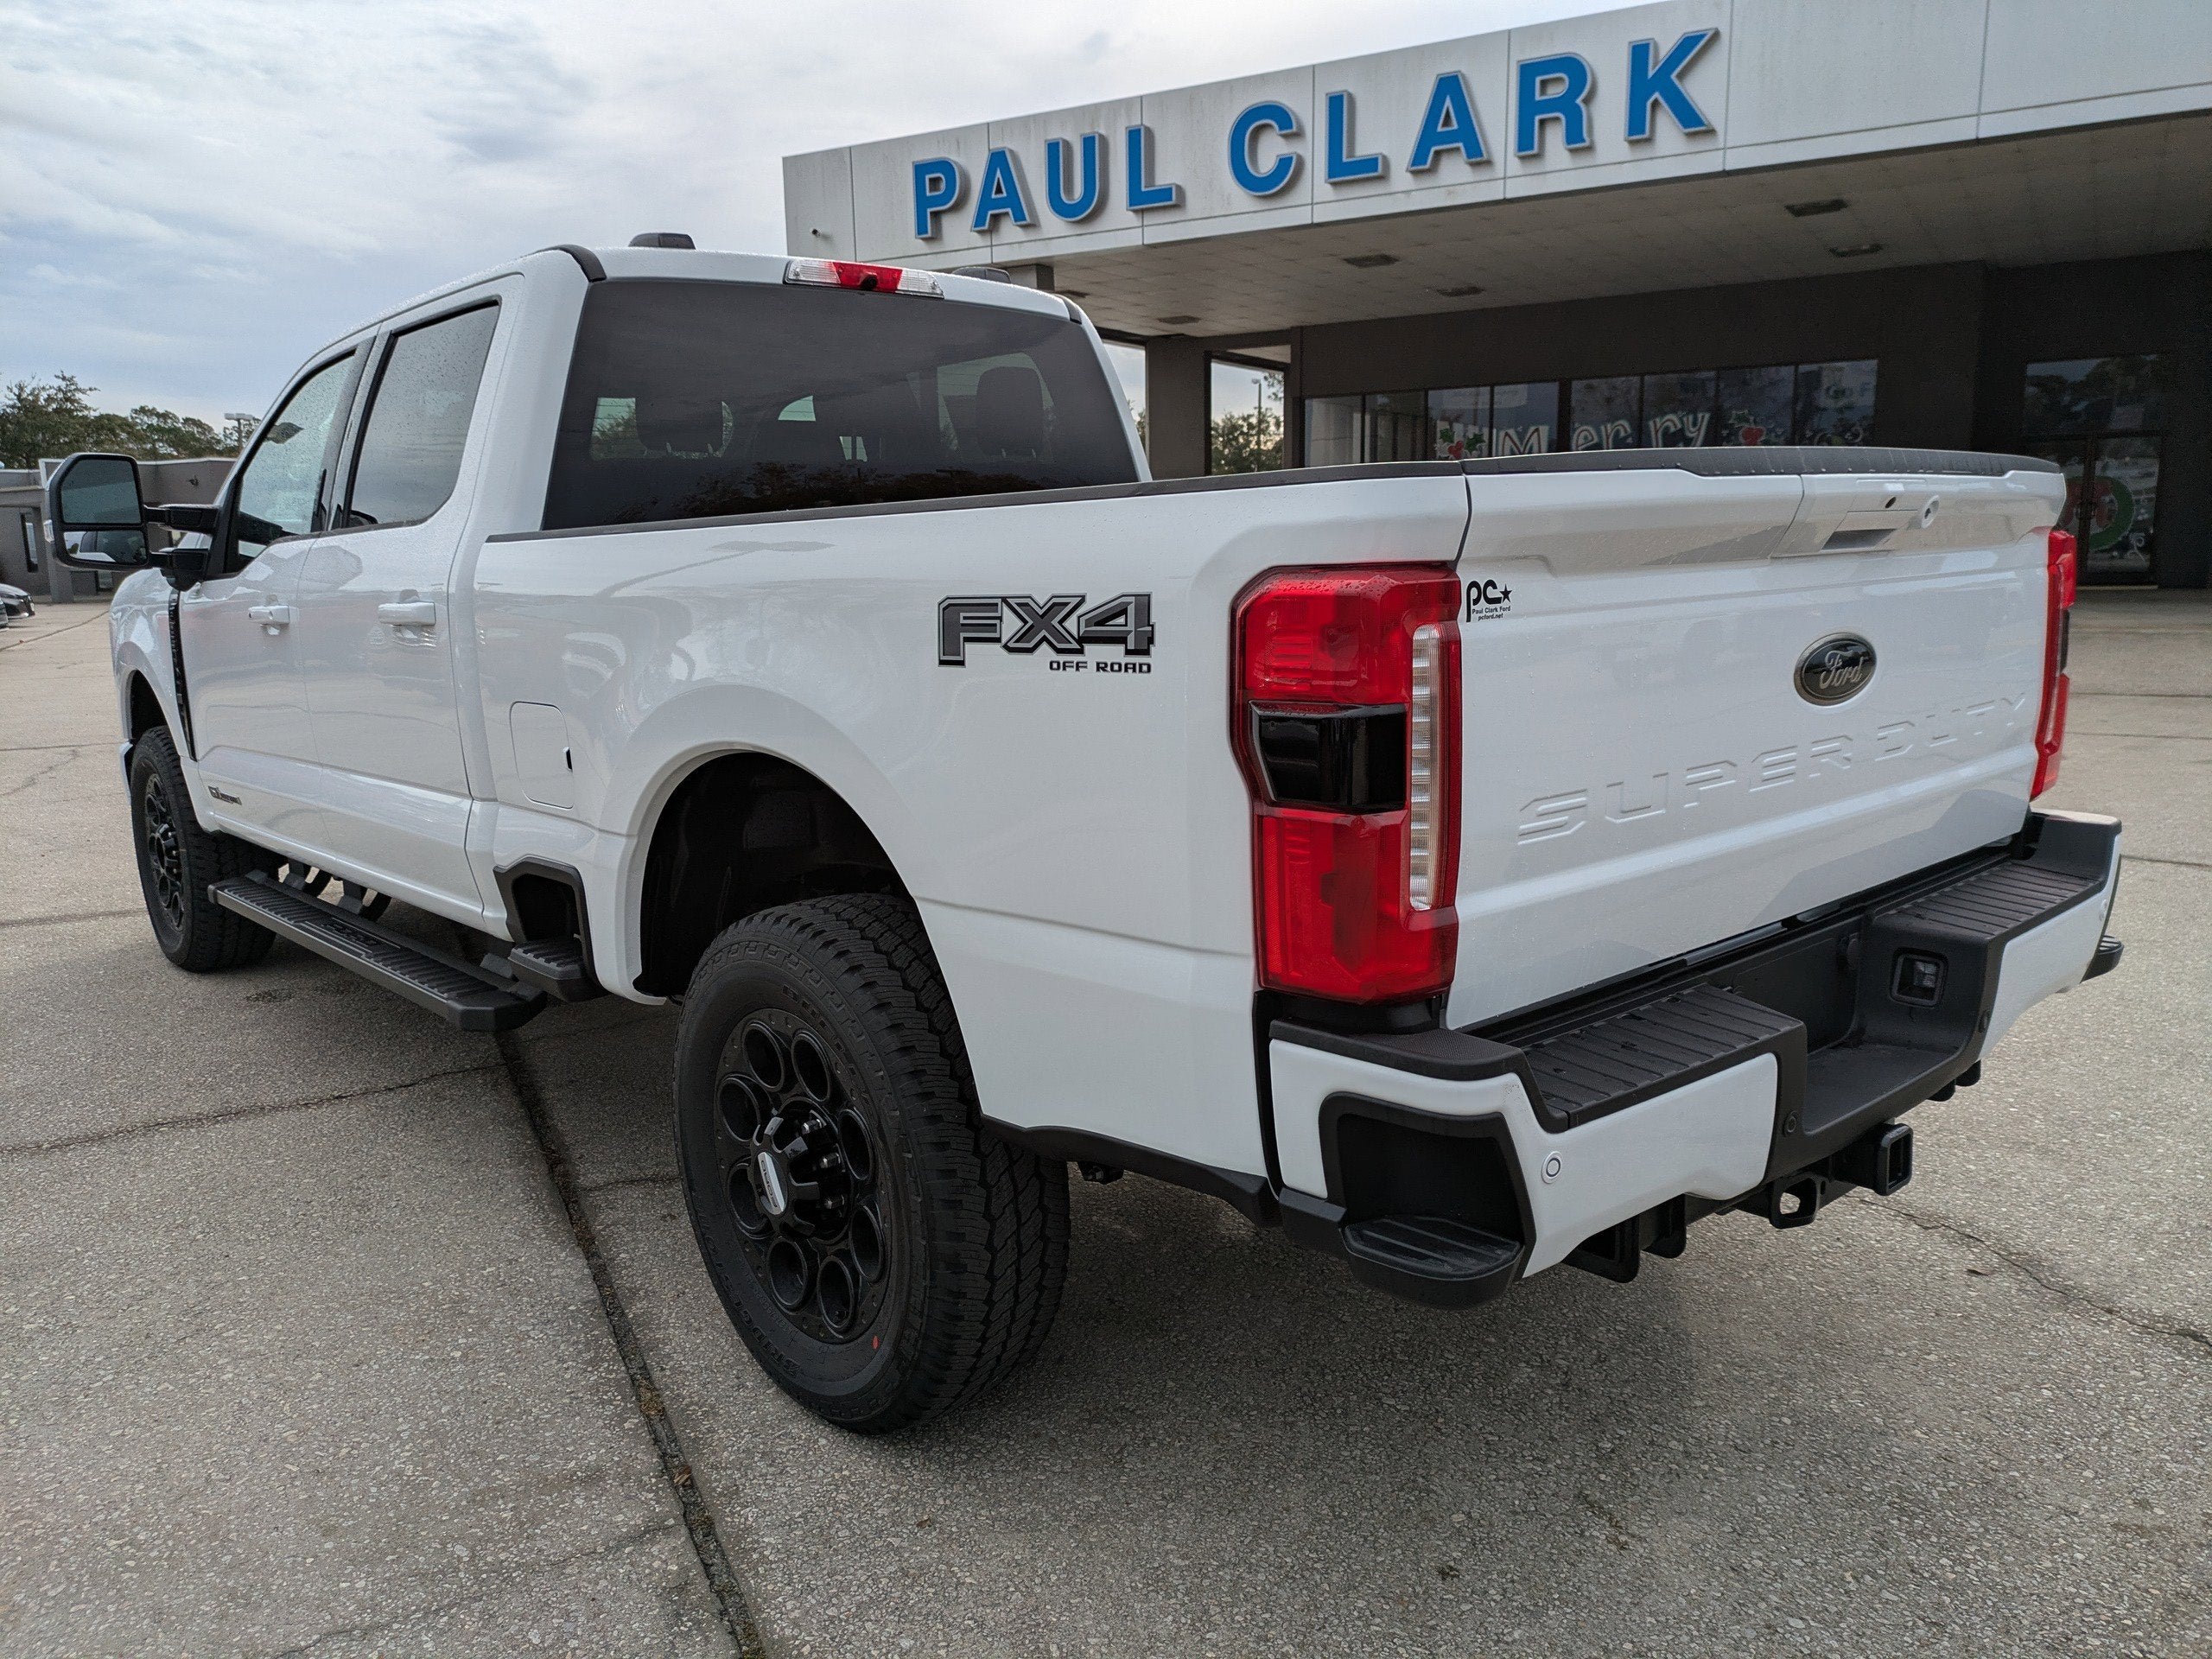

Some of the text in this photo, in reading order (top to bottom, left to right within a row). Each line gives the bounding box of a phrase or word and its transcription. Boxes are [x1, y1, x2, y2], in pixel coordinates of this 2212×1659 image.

[912, 27, 1719, 241] PAUL CLARK
[938, 591, 1156, 668] FX4
[1049, 660, 1152, 674] OFF ROAD
[1516, 692, 2027, 847] SUPER DUTY
